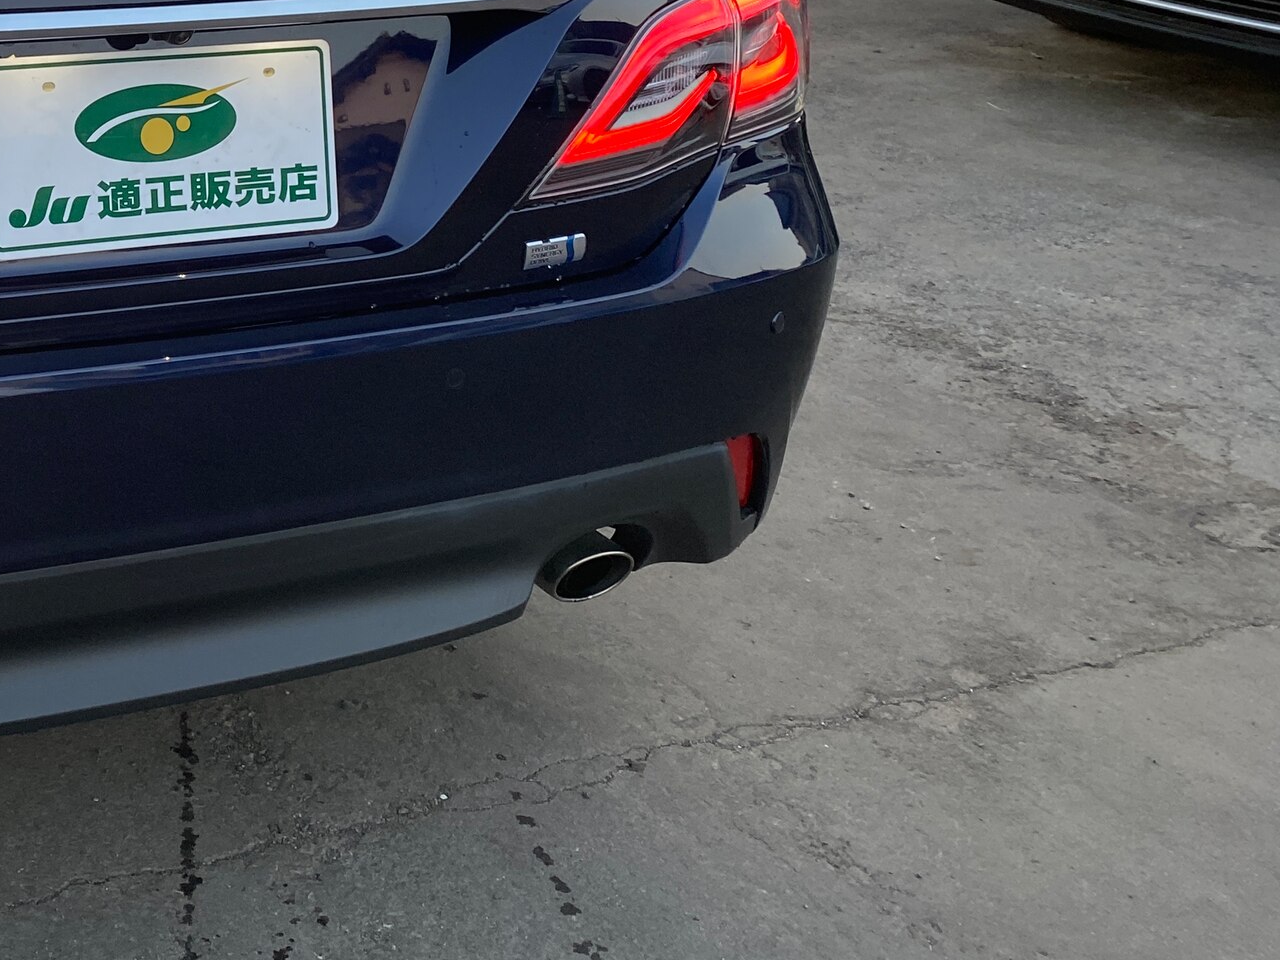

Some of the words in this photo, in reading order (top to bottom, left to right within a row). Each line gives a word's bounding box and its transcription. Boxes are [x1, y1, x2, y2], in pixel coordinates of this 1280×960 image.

[97, 163, 318, 220] 適正販売店
